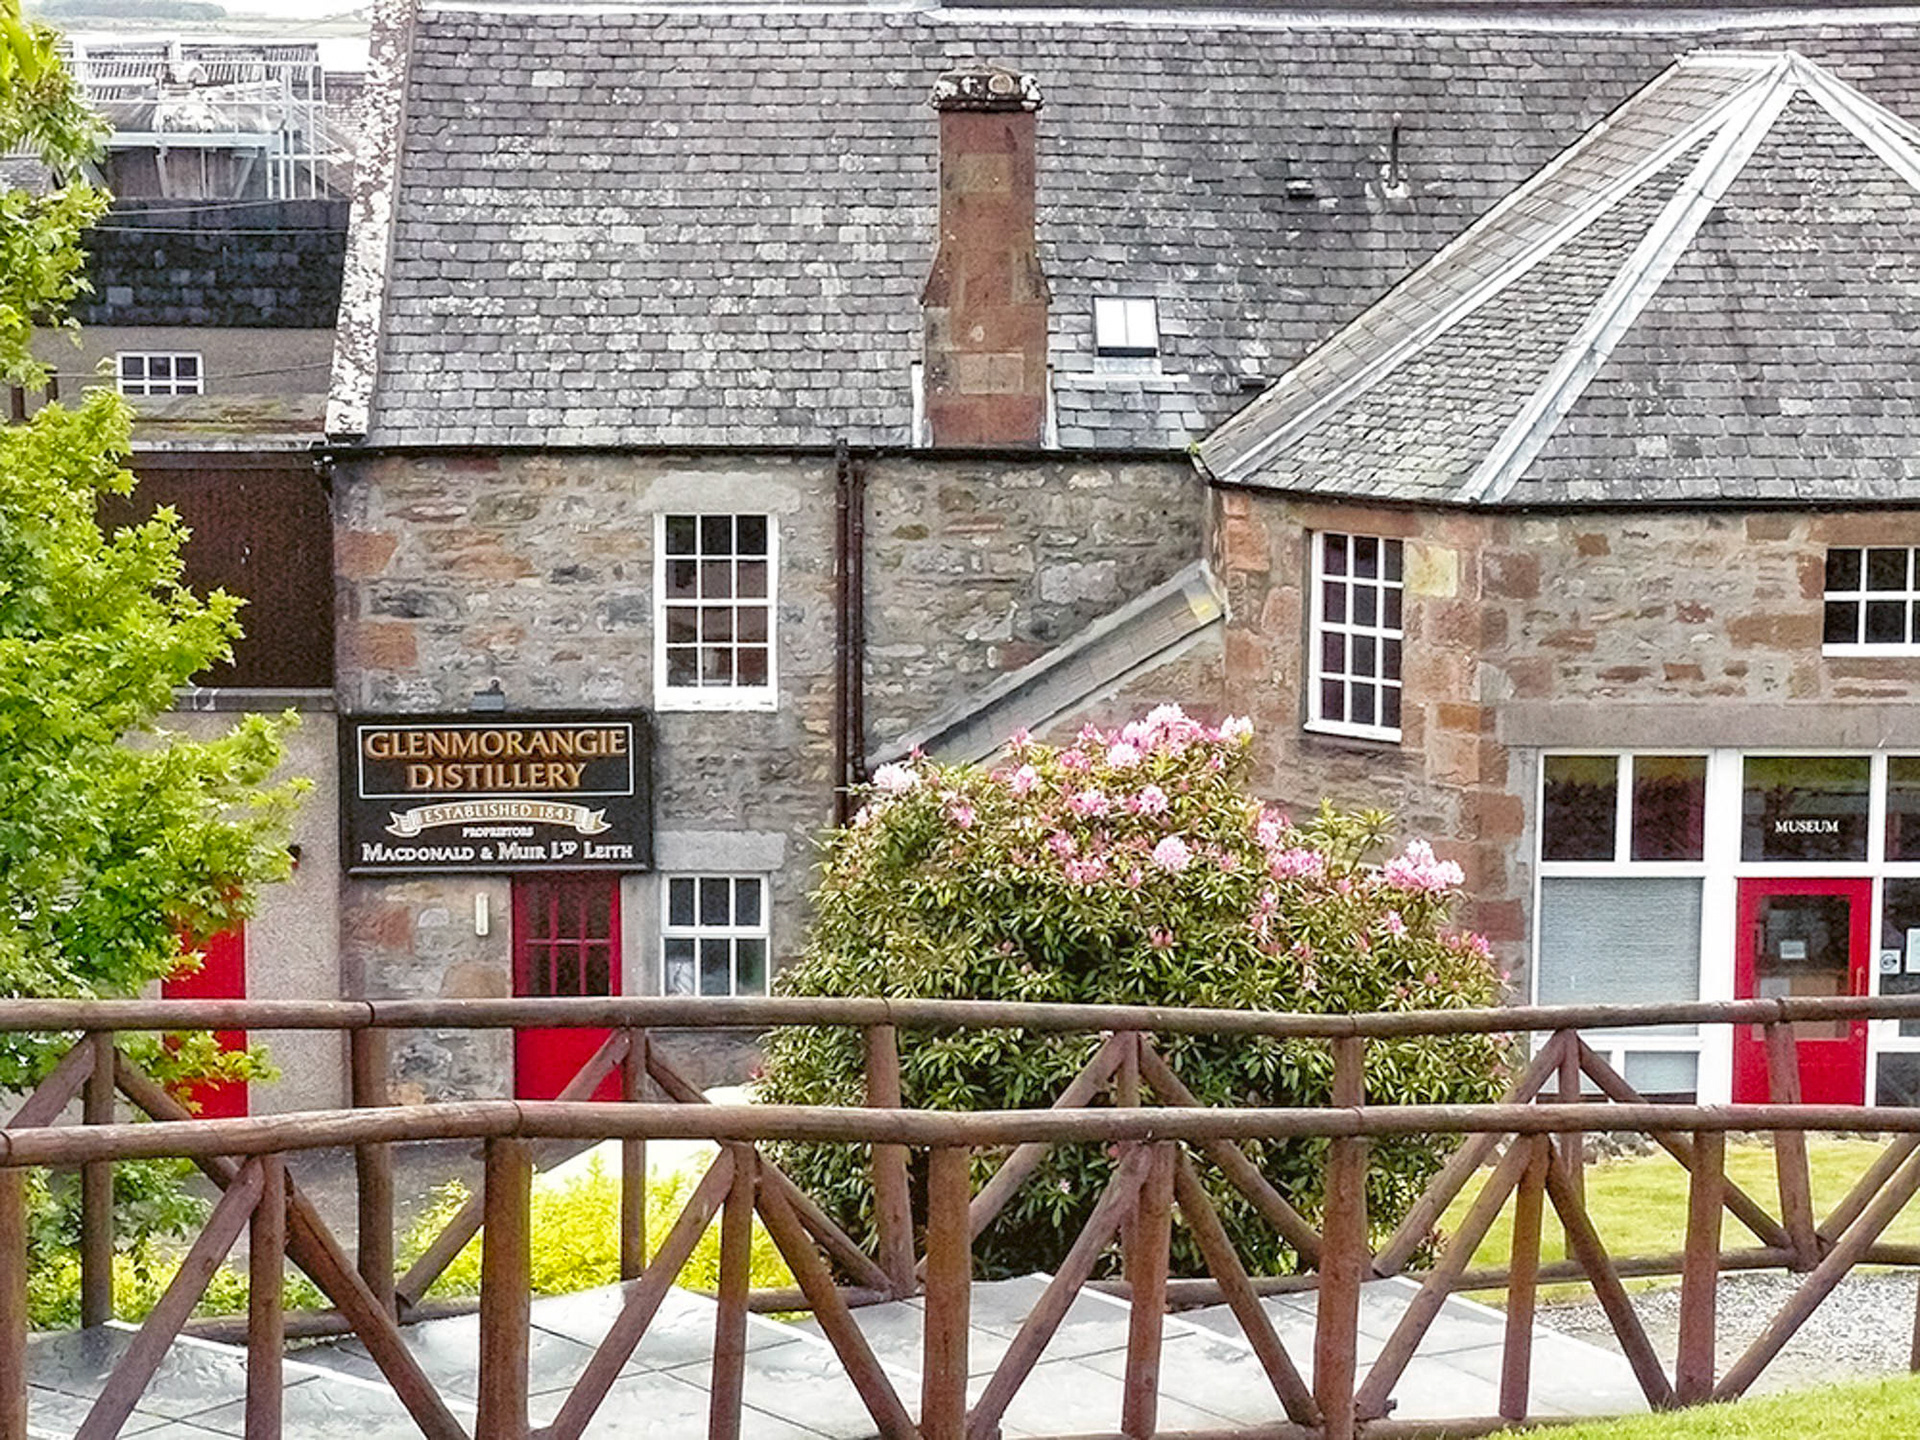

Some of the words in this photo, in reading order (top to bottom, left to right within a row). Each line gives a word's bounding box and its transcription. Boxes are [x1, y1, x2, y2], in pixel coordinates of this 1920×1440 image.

[366, 730, 627, 757] GLENMORANGIE
[410, 763, 586, 789] DISTILLERY
[424, 803, 532, 823] ESTABLISHED
[538, 807, 573, 822] 1843
[462, 827, 534, 838] PROPRIETORS
[1774, 820, 1839, 833] MUSEUM
[481, 848, 493, 860] &
